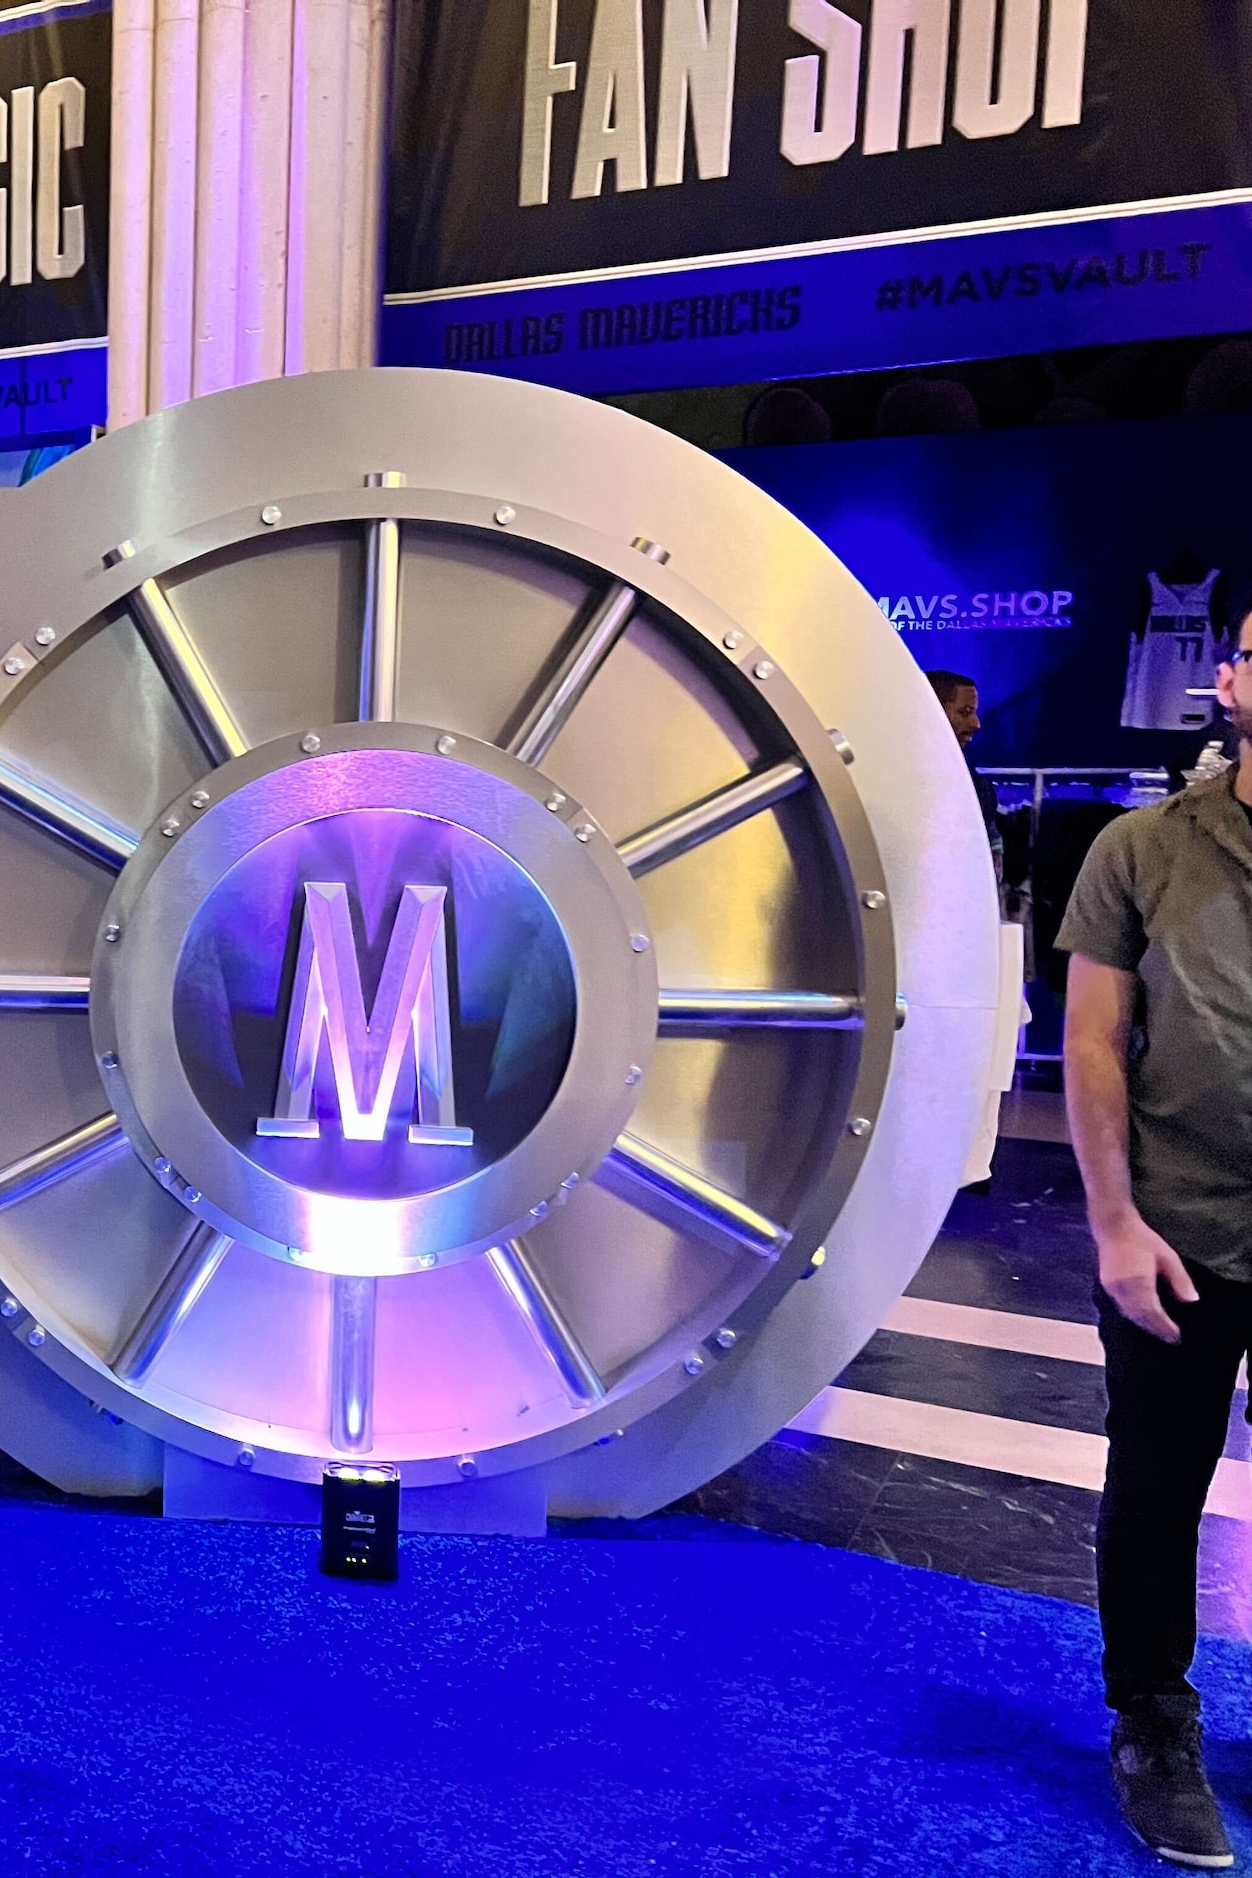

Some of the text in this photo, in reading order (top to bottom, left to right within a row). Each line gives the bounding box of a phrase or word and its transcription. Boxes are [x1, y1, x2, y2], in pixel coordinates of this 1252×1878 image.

[519, 0, 738, 207] FAN
[875, 242, 1210, 312] #MAVSVAULT
[444, 284, 803, 364] DALLAS MAVERICKS
[909, 620, 933, 631] THE
[1175, 636, 1204, 662] 77
